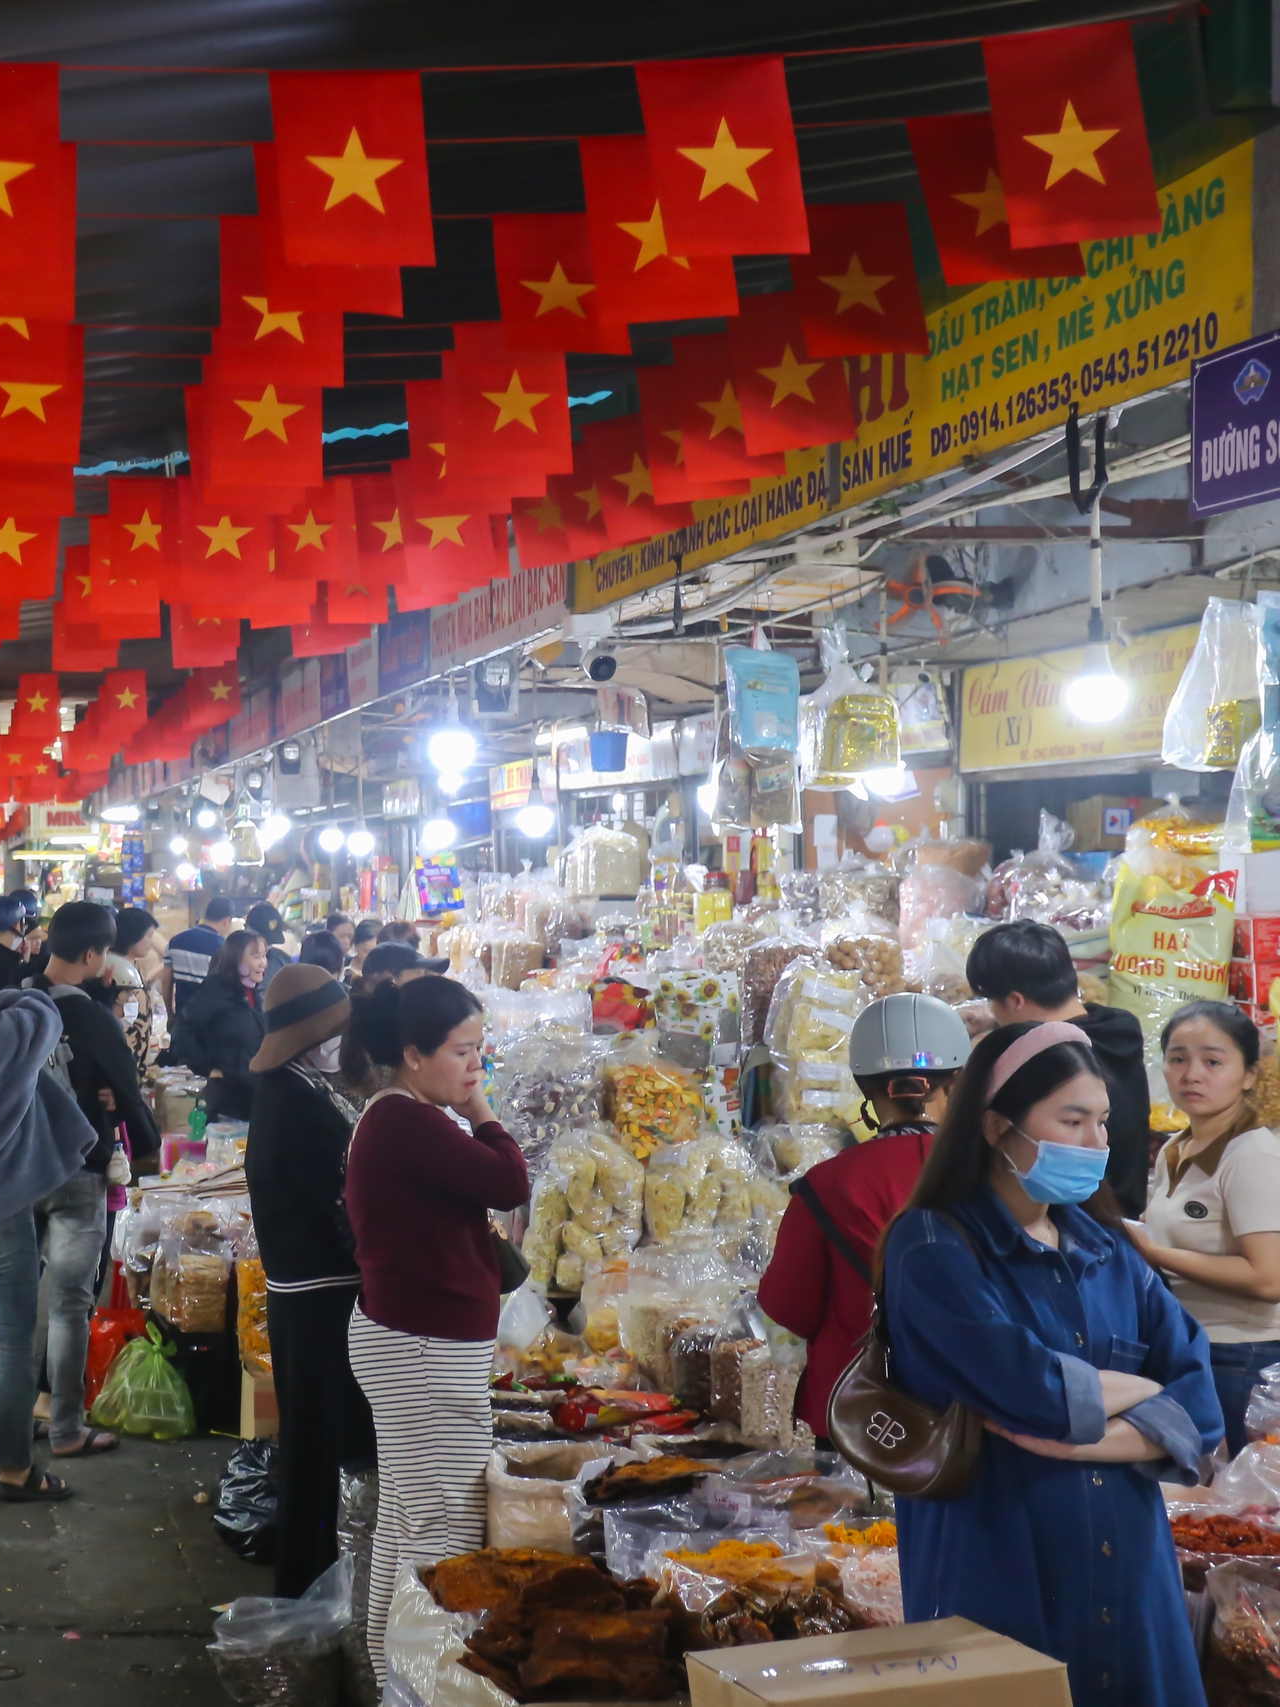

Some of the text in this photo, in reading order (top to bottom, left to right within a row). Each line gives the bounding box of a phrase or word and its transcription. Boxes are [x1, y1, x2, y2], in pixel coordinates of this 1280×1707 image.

[941, 354, 984, 403] HẠT
[1057, 294, 1094, 351] MÈ
[640, 539, 665, 574] KINH
[734, 492, 762, 538] LOẠI
[879, 410, 913, 478] HUẾ
[1201, 419, 1280, 483] ĐƯỜNG S
